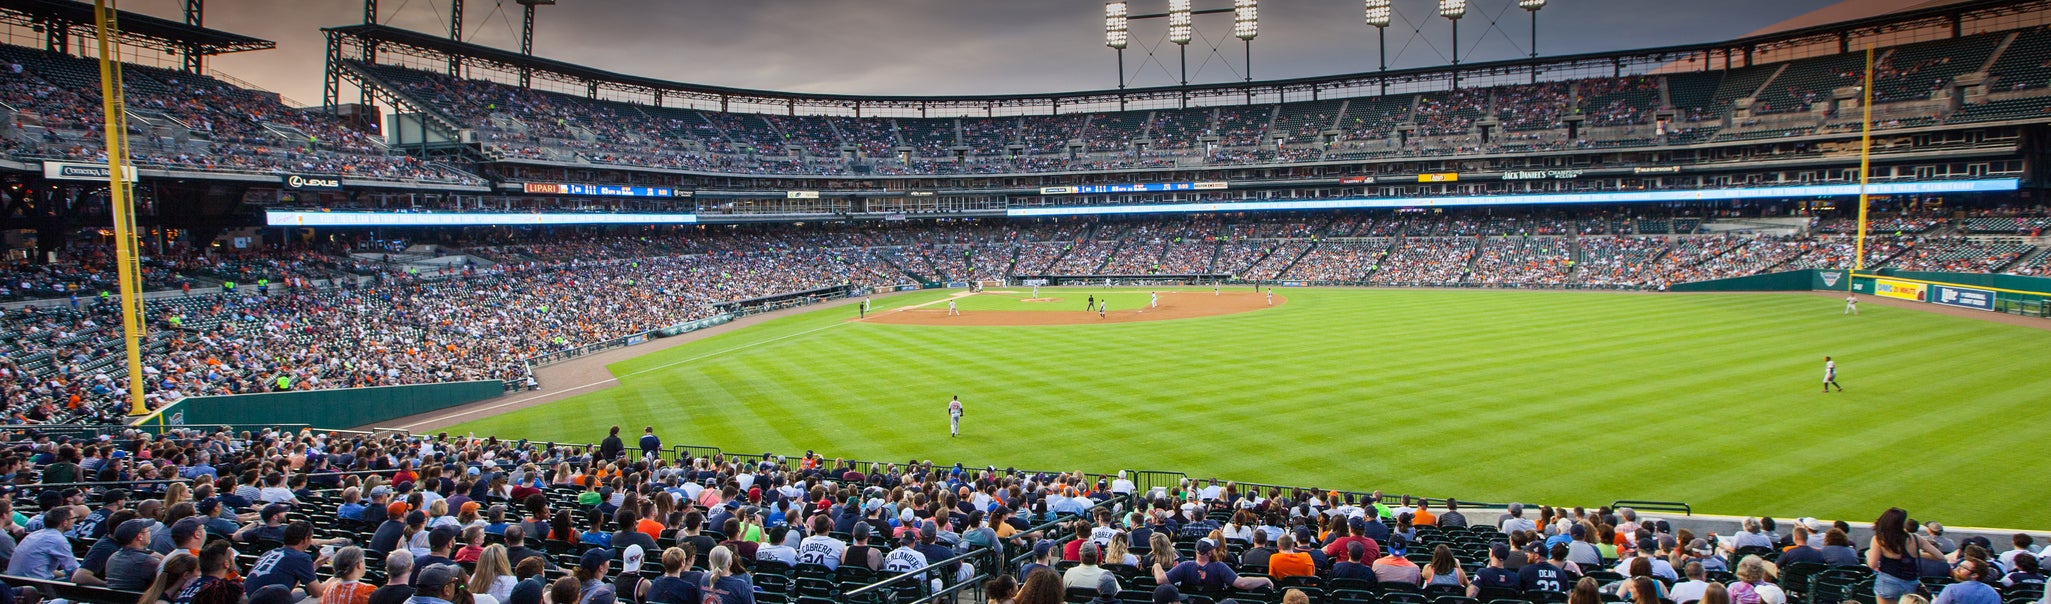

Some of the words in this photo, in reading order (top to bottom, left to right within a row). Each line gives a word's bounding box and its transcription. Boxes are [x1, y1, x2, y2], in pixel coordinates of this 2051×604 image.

[1502, 171, 1518, 180] JACK
[303, 178, 339, 187] LEXUS
[529, 183, 556, 192] LIPARI
[801, 542, 833, 556] CABRERA
[1538, 569, 1557, 579] DEAN
